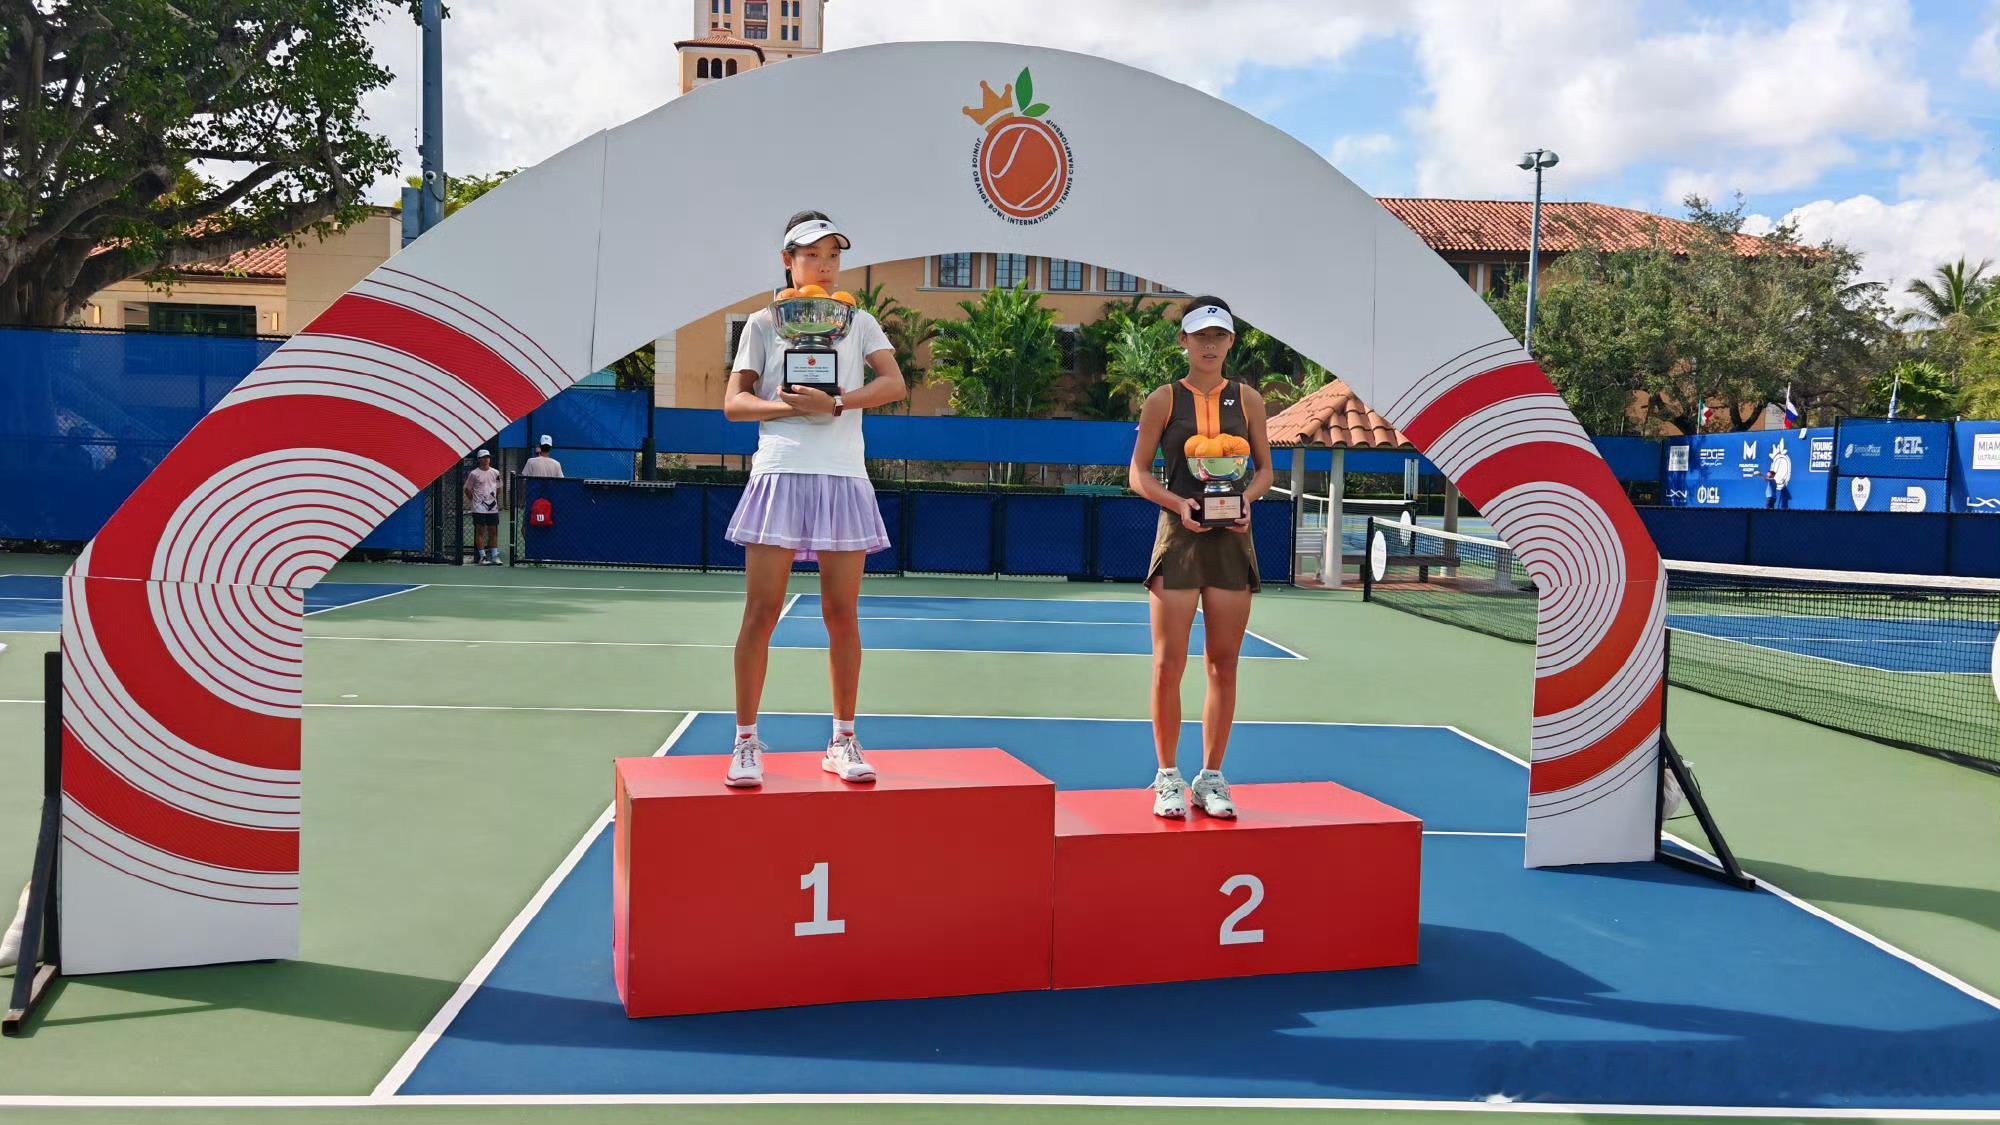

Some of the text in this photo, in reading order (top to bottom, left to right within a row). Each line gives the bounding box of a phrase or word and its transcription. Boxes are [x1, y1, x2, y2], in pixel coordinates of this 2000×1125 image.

[972, 119, 1074, 226] JUNIOR ORANGE BOWL INTERNATIONAL TENNIS CHAMPIONSHIP
[1812, 442, 1833, 451] YOUNG
[795, 863, 845, 936] 1
[1220, 875, 1264, 945] 2
